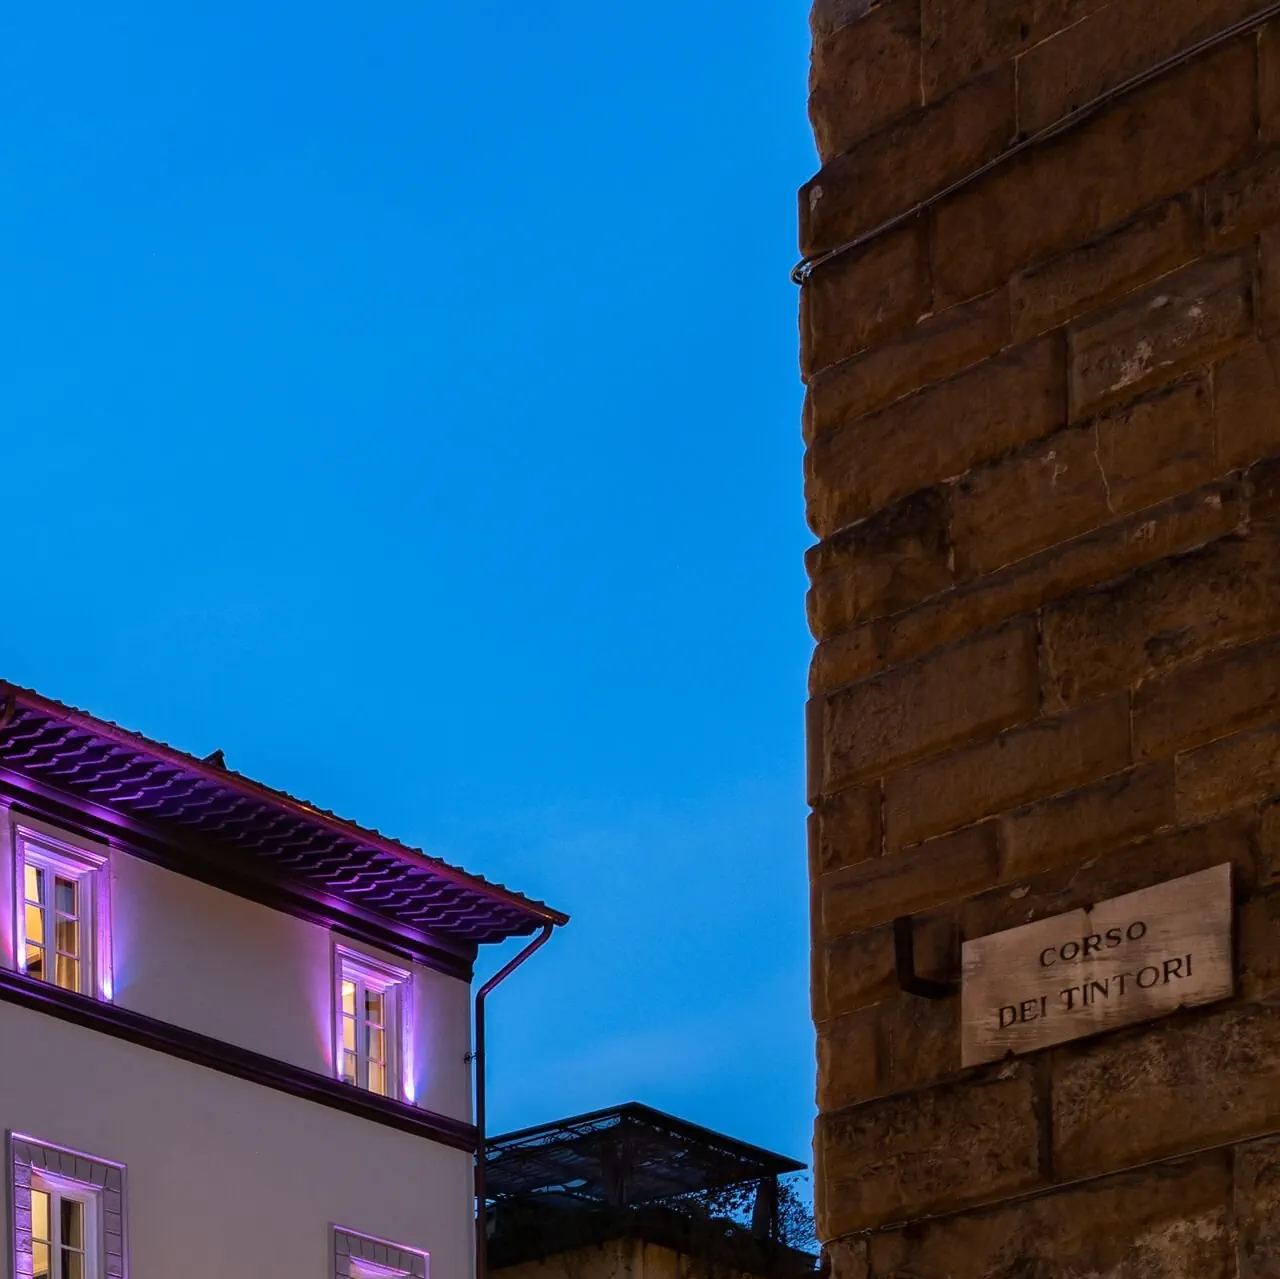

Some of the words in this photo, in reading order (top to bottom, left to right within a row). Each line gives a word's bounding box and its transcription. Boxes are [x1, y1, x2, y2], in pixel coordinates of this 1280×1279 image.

[1040, 921, 1147, 968] CORSO
[999, 996, 1047, 1030] DEI
[1060, 953, 1193, 1011] TINTORI
